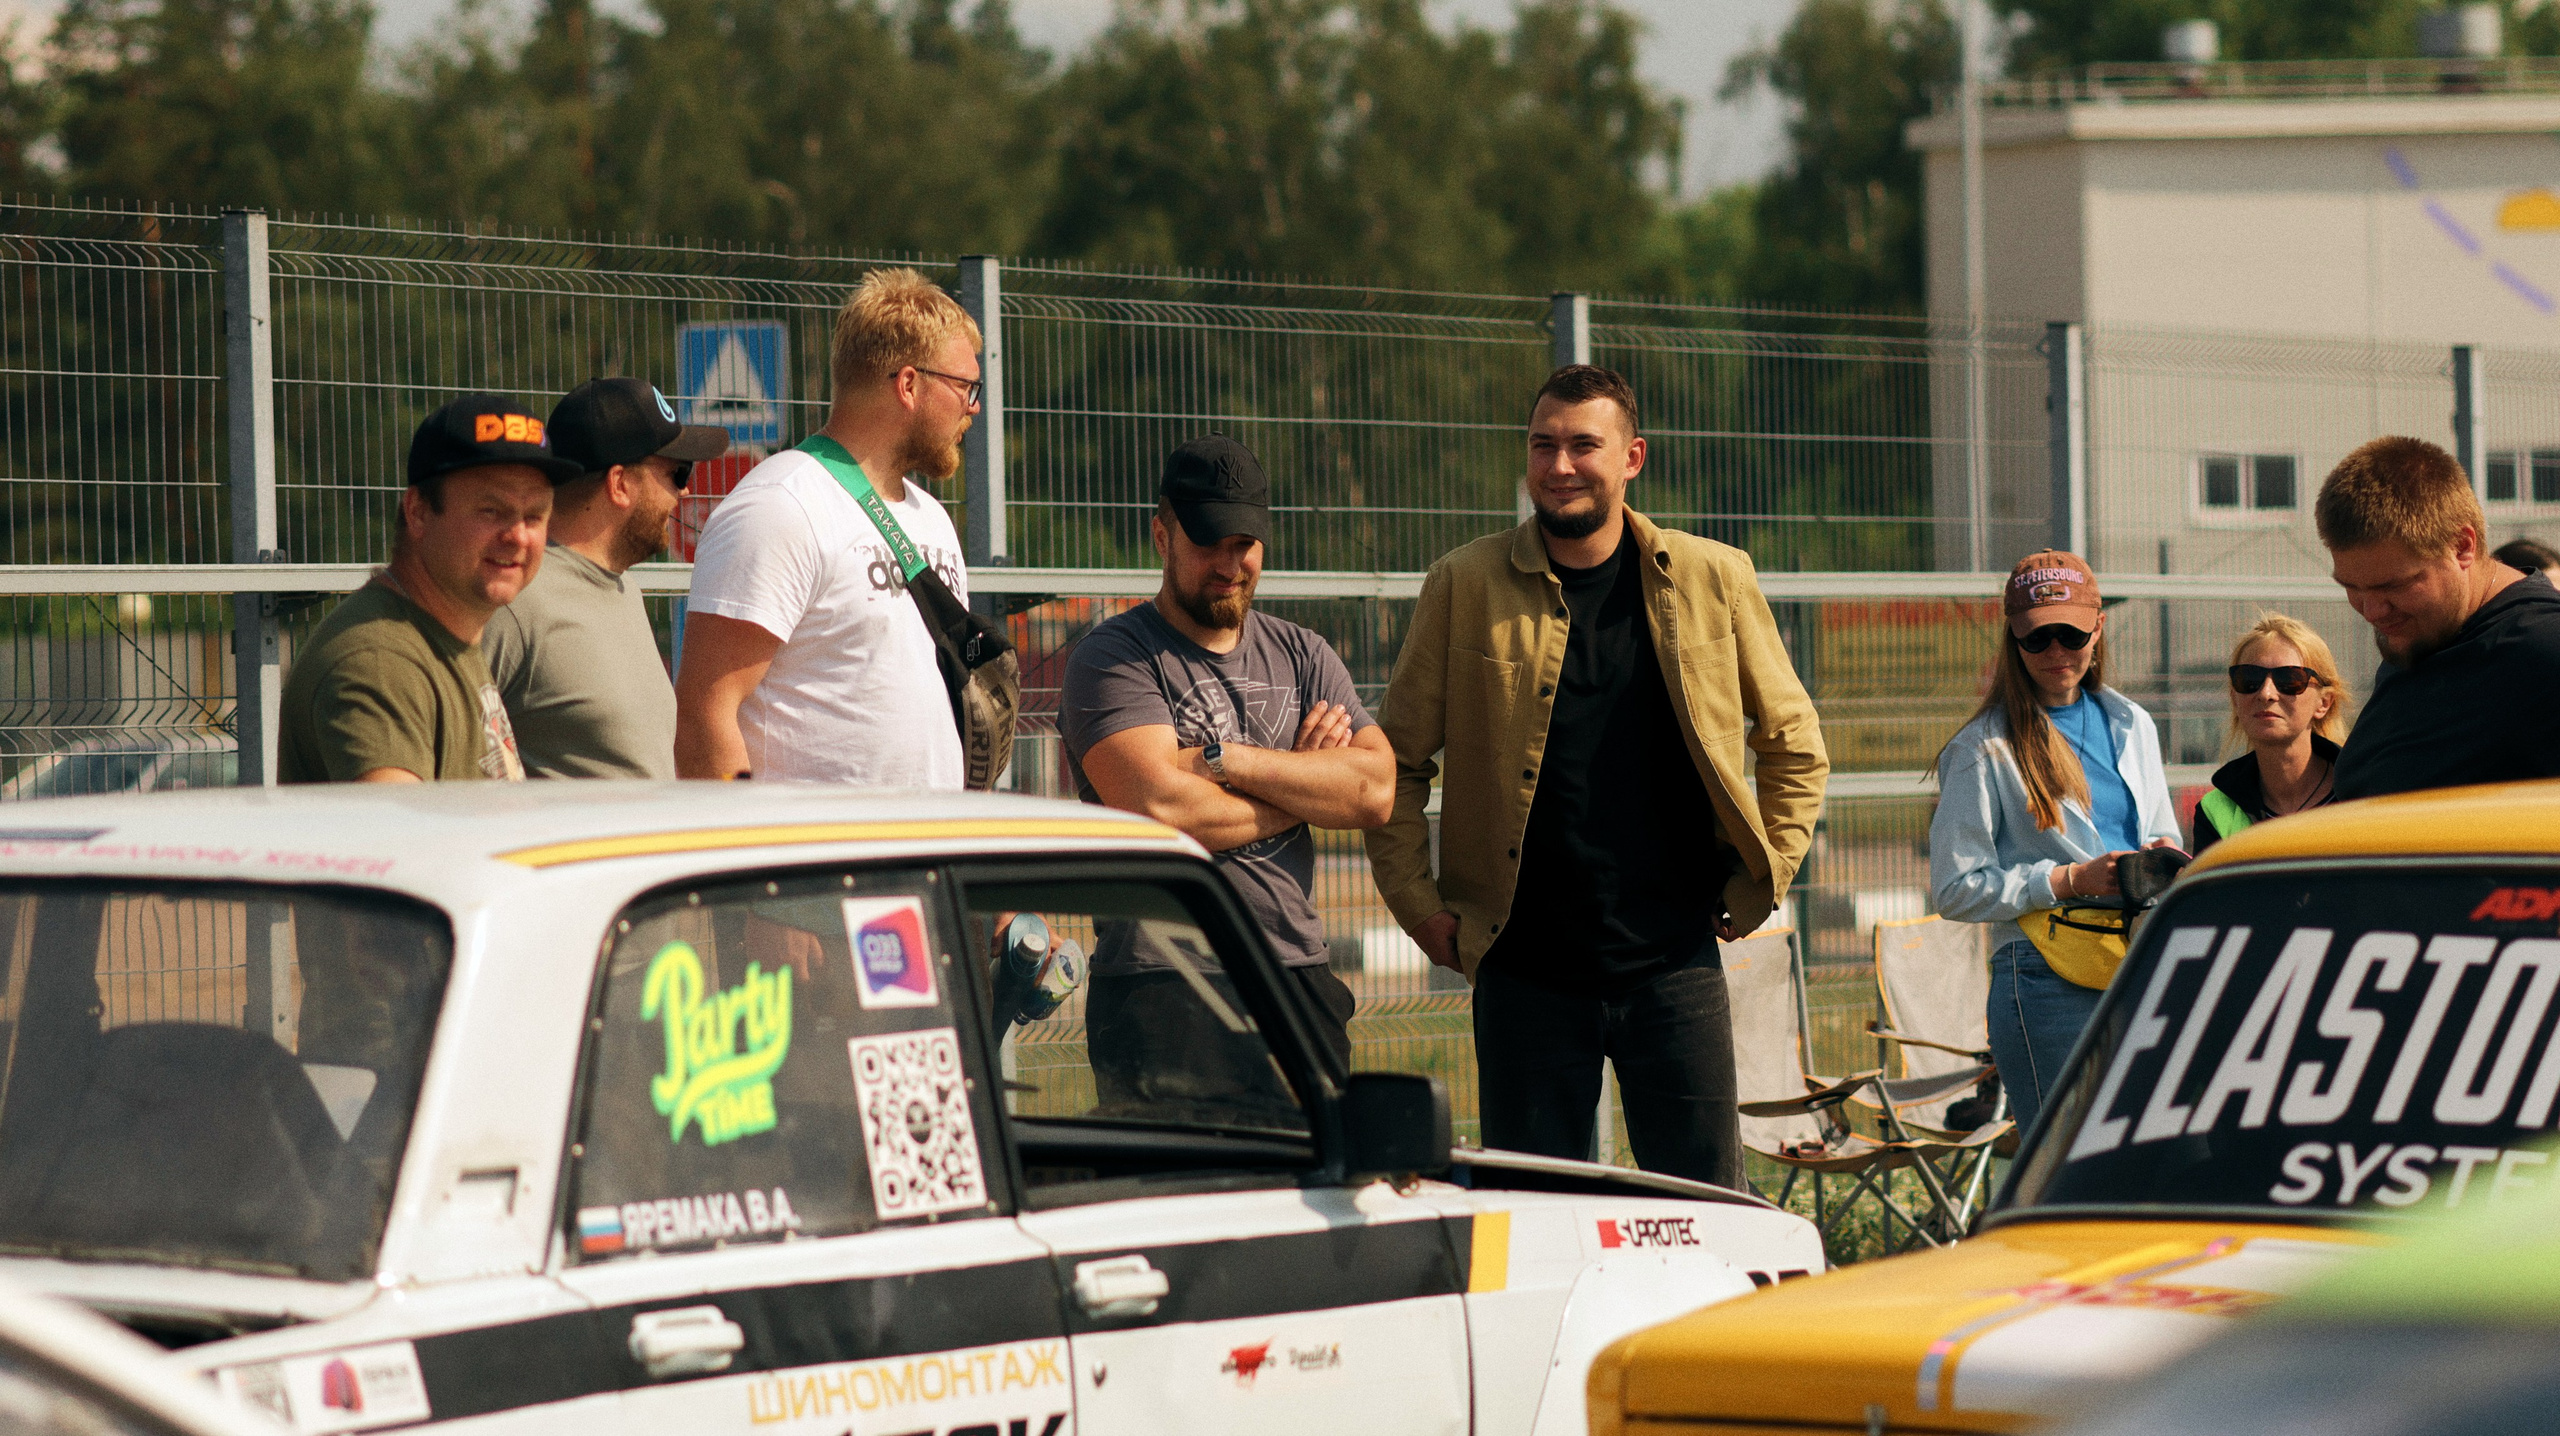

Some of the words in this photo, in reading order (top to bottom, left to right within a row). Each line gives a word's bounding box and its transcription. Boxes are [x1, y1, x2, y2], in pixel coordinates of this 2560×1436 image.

[867, 495, 915, 565] TAKATA
[642, 940, 793, 1136] Party
[2066, 926, 2560, 1162] ELASTO
[694, 1080, 778, 1146] TIME
[621, 1192, 749, 1248] ЯРЕМАКА
[747, 1342, 1066, 1425] ШИНОМОНТАЖ
